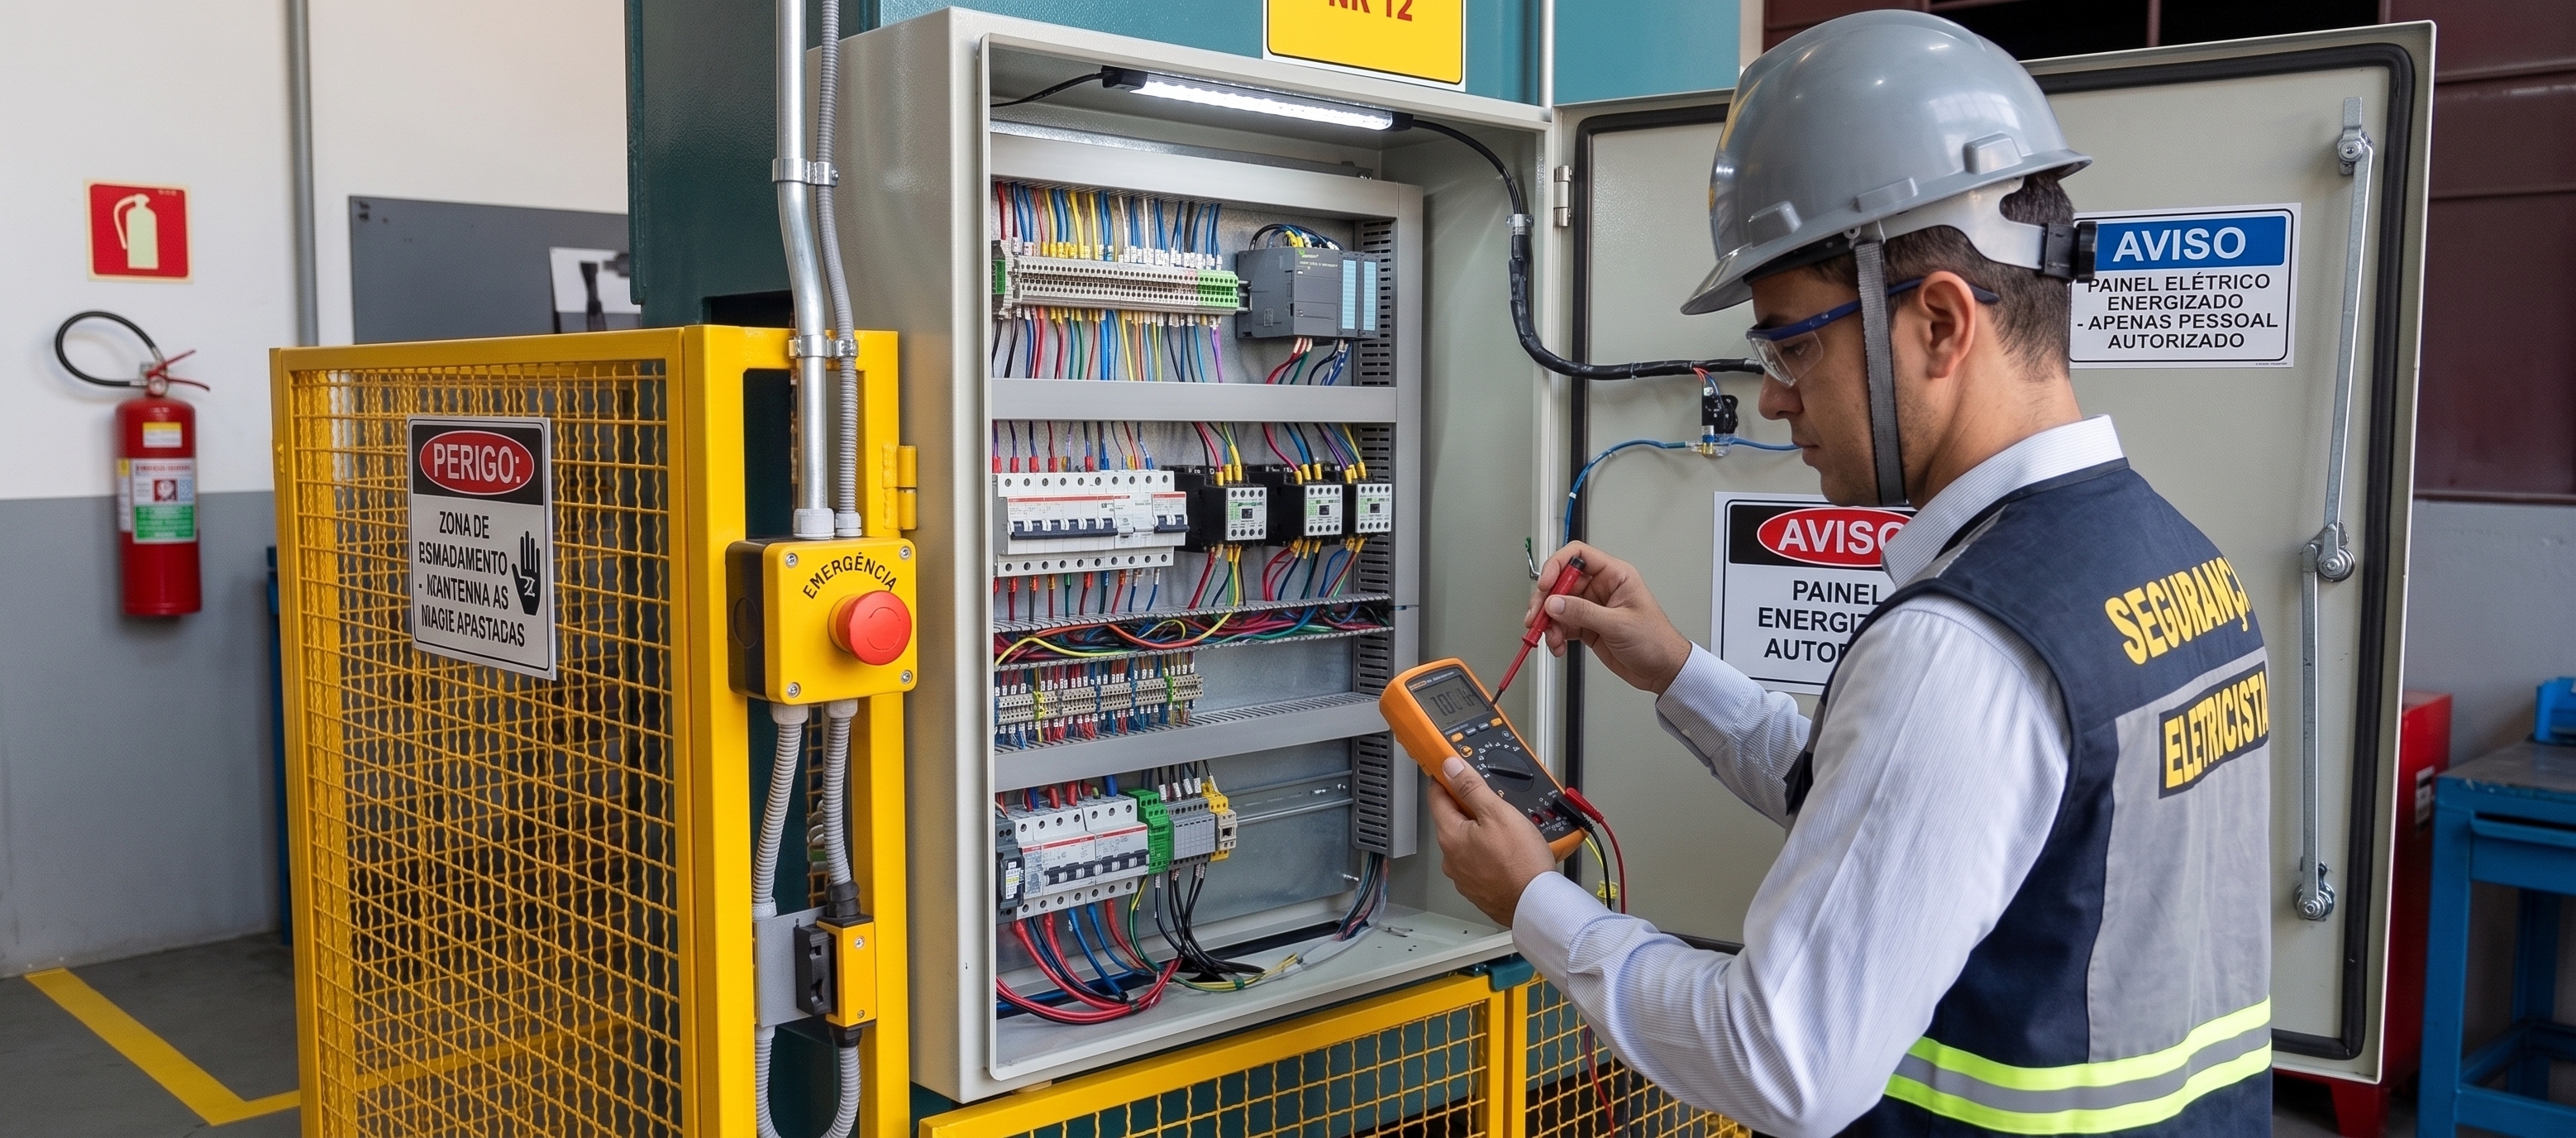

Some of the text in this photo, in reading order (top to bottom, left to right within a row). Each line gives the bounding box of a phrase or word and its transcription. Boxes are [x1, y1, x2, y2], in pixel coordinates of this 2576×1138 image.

[2112, 227, 2246, 262] AVISO
[2087, 272, 2270, 293] PAINEL ELÉTRICO
[2108, 294, 2244, 311] ENERGIZADO
[2088, 314, 2172, 330] APENAS
[2179, 313, 2278, 329] PESSOAL
[2108, 332, 2244, 349] AUTORIZADO
[433, 442, 521, 484] PERIGO:
[439, 510, 489, 539] ZONA DE
[493, 585, 509, 610] AS
[1792, 580, 1884, 605] PAINEL
[1758, 607, 1869, 634] ENERGI
[2164, 671, 2269, 789] ELETRICISTA
